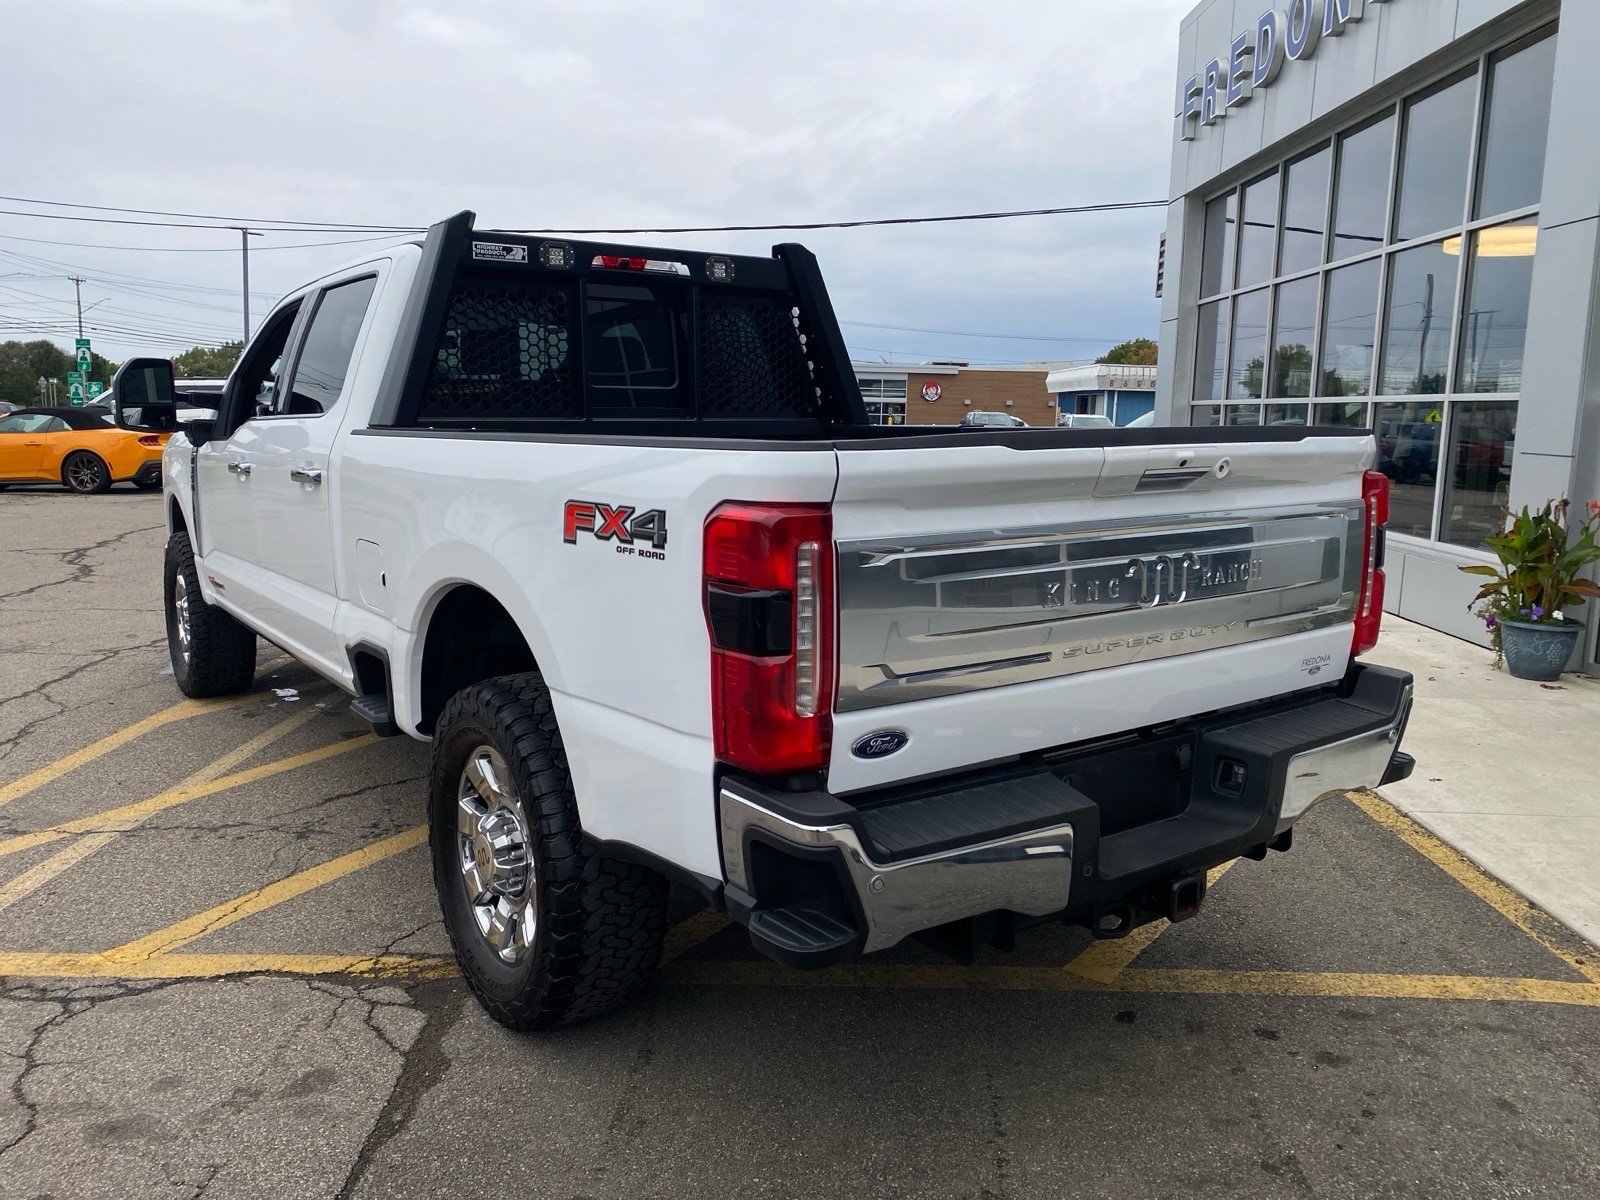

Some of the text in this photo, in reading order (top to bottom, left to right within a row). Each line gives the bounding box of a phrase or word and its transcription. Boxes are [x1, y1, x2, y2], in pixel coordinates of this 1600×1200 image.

[563, 499, 668, 551] FX4
[616, 545, 666, 561] OFF ROAD
[1043, 559, 1263, 608] KING RANCH
[1063, 620, 1237, 659] SUPER DUTY
[866, 736, 898, 754] Ford
